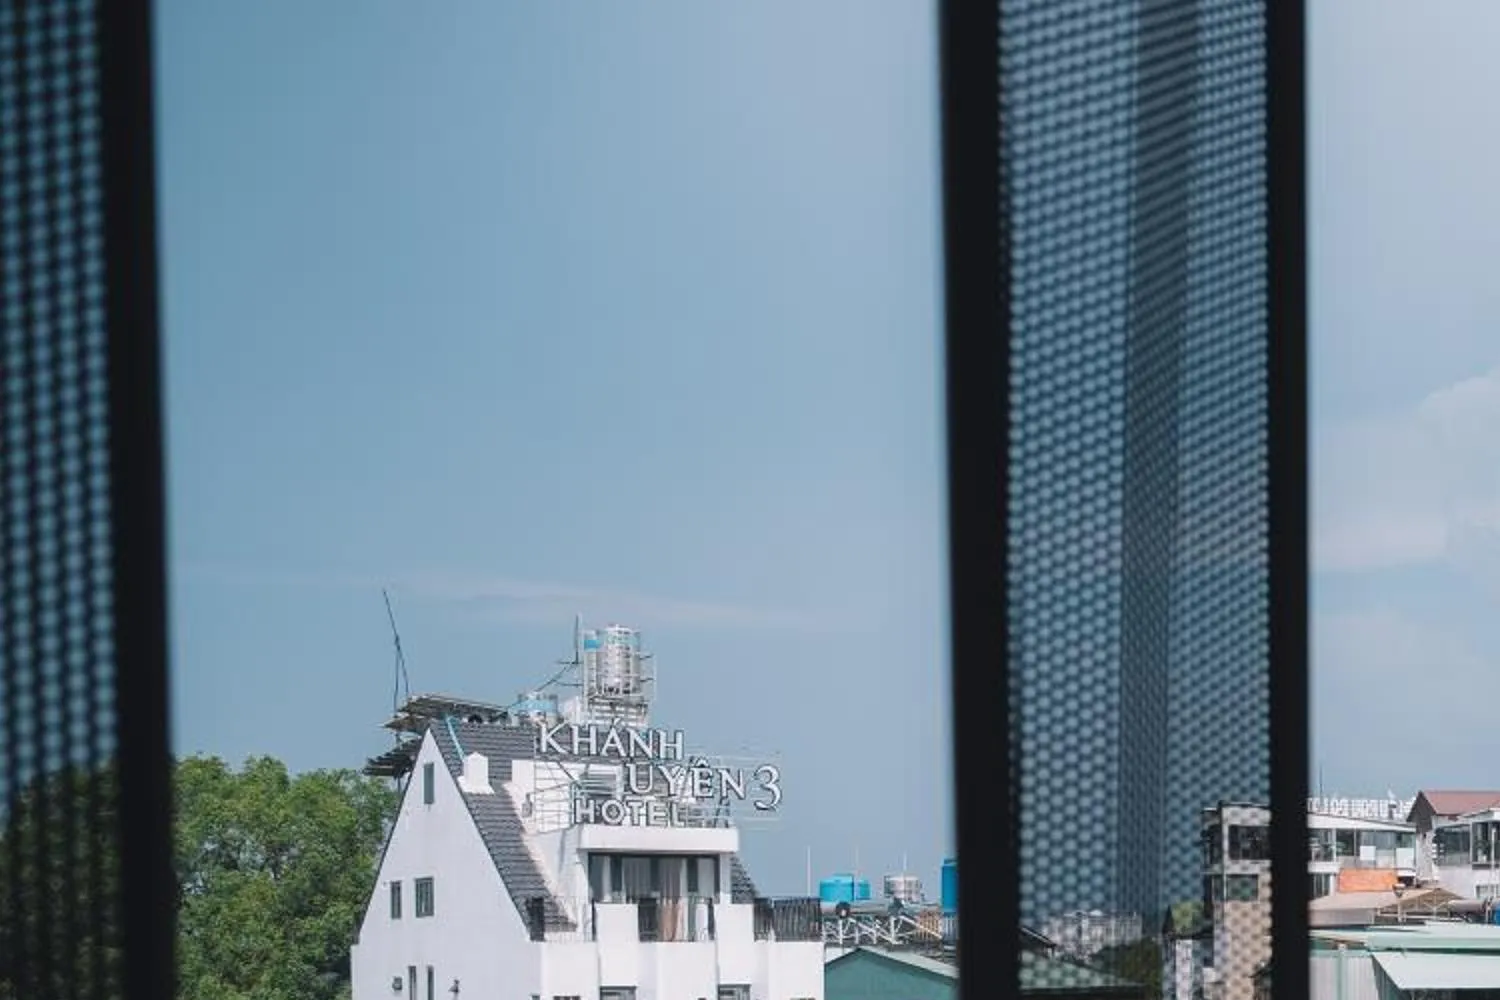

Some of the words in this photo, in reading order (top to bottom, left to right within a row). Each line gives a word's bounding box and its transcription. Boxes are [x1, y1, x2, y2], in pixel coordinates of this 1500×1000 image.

[538, 717, 684, 760] KHÁNH
[625, 757, 745, 799] UYÊN
[753, 764, 782, 811] 3
[573, 798, 687, 827] HOTEL
